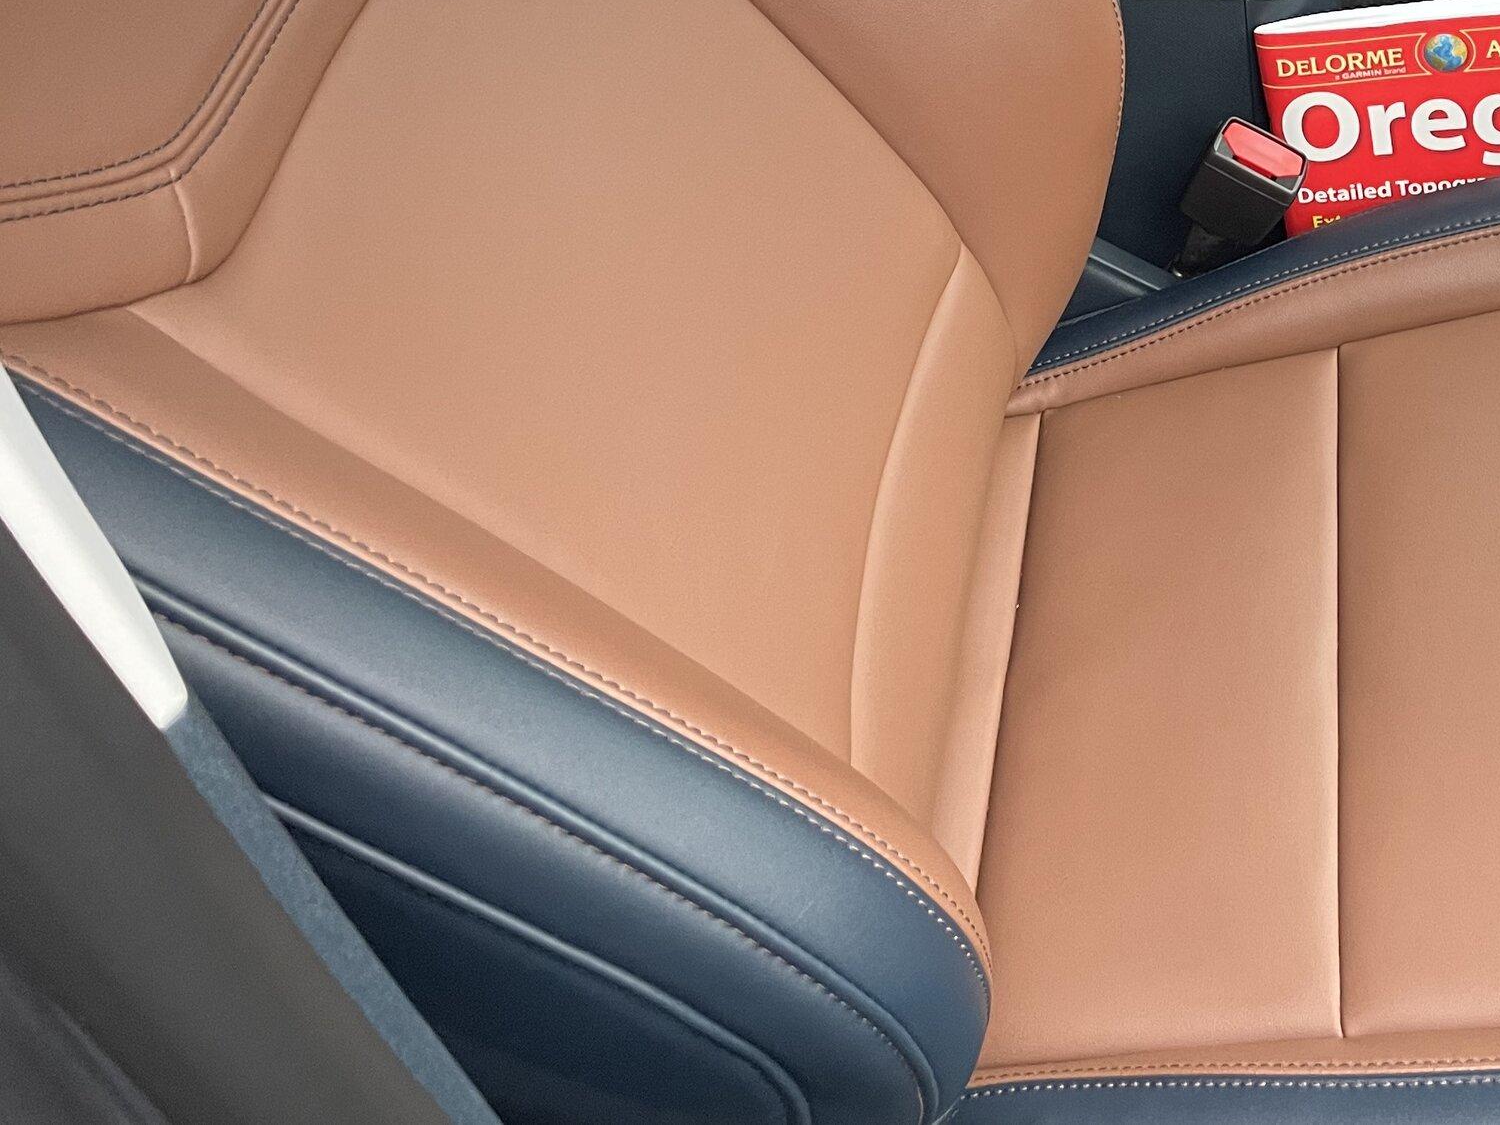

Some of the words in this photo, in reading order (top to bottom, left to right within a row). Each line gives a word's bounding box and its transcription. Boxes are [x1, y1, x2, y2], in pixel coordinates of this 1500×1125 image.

[1341, 69, 1382, 81] GARMIN
[1384, 66, 1407, 76] brand
[1298, 181, 1393, 205] Detailed
